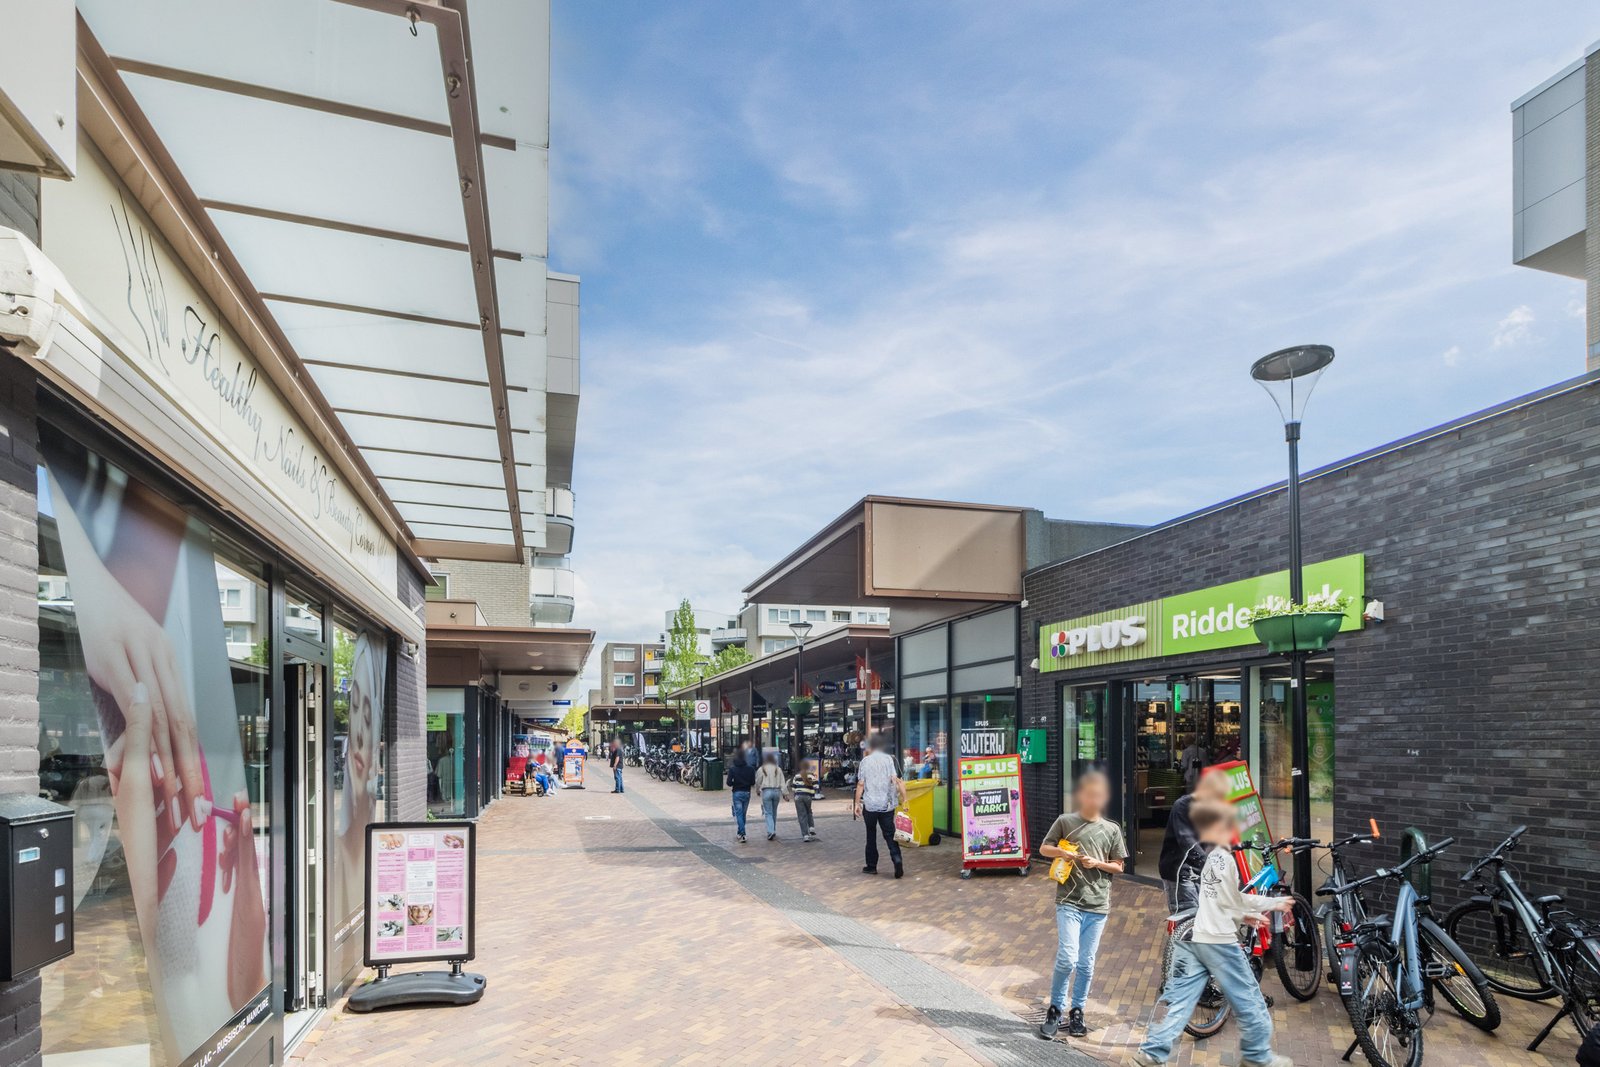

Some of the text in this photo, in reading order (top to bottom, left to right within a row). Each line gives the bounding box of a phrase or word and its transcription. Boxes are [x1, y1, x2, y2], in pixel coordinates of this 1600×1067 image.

[181, 305, 262, 461] Healthy
[264, 425, 306, 488] Nails
[324, 478, 354, 553] Beauty
[355, 507, 375, 556] Corner
[1069, 616, 1147, 655] PLUS
[961, 732, 1005, 754] SLIJTERIJ
[974, 761, 1017, 775] PLUS
[975, 803, 1008, 814] MARKT
[981, 795, 1002, 804] TUIN
[246, 996, 269, 1026] MANICURE
